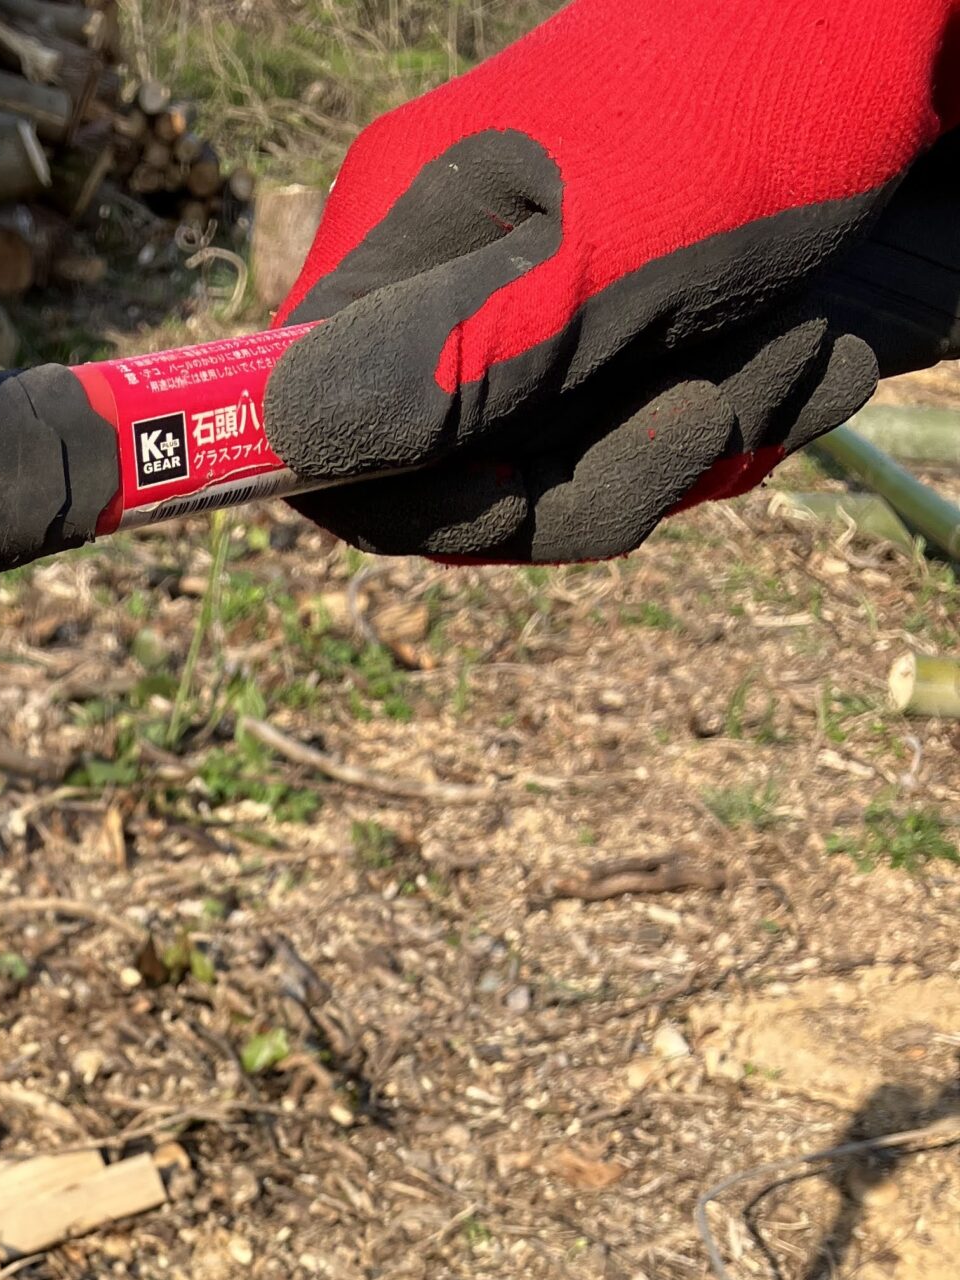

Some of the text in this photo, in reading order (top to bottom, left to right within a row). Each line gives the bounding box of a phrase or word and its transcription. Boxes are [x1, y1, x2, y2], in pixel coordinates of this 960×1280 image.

[192, 402, 265, 447] 石頭ハ
[143, 456, 181, 474] GEAR
